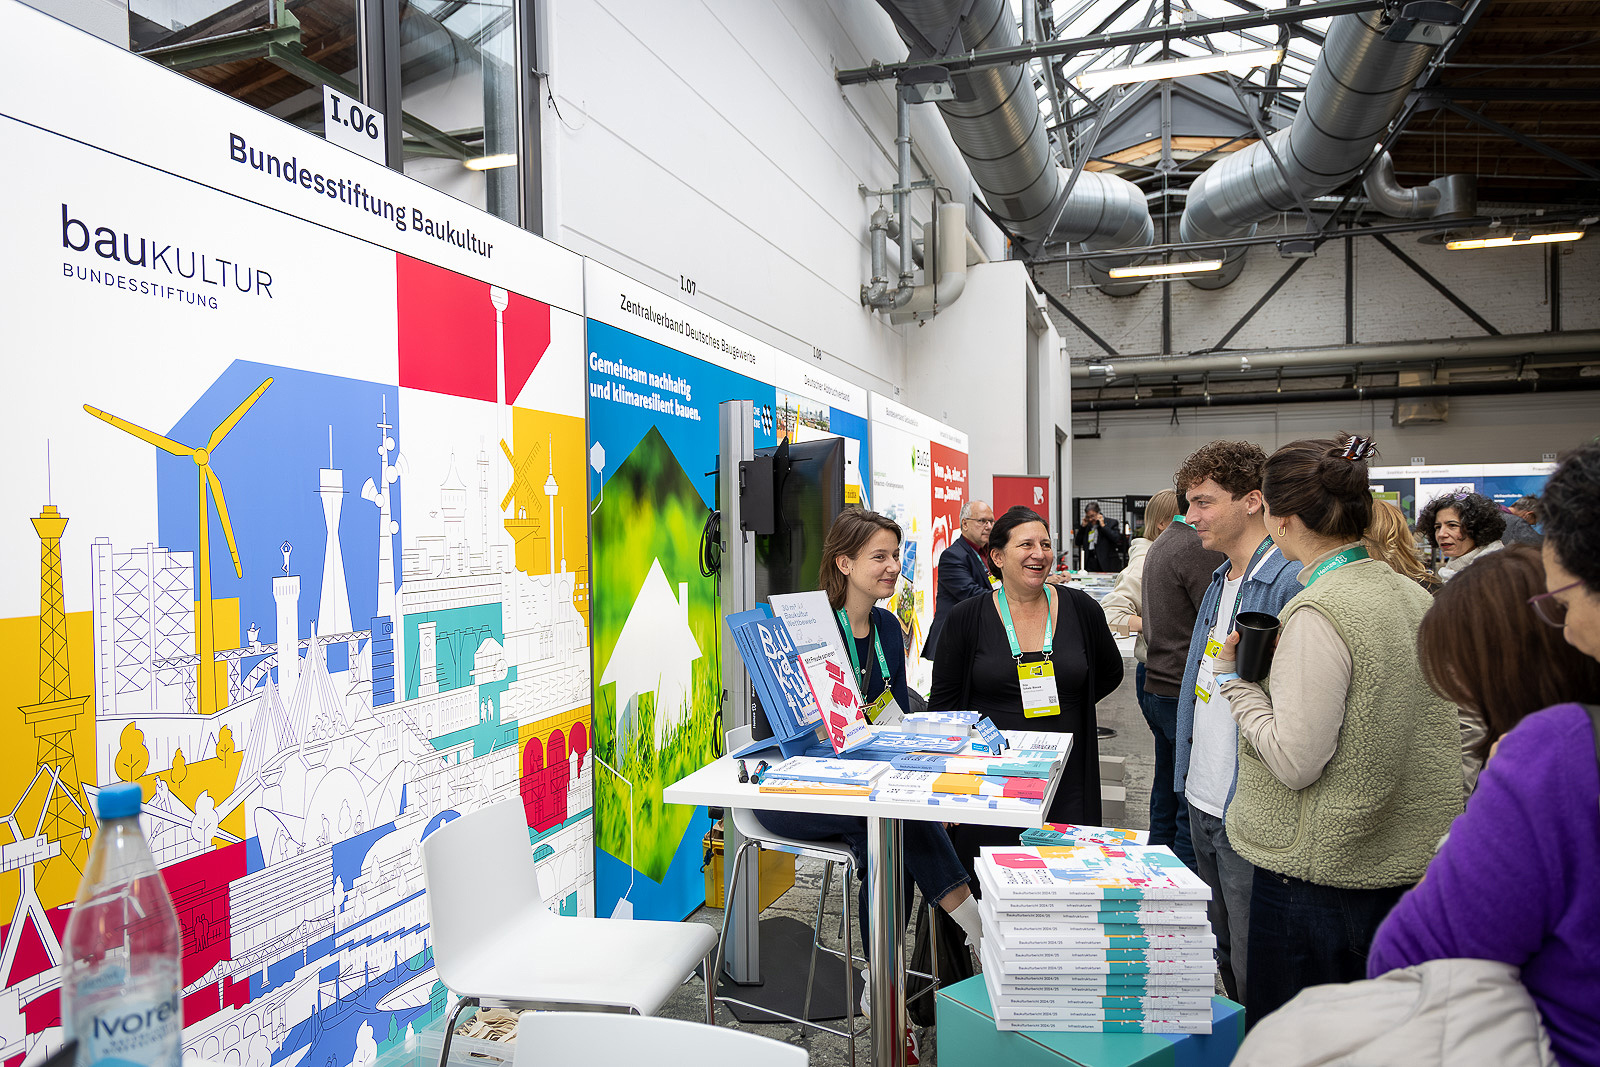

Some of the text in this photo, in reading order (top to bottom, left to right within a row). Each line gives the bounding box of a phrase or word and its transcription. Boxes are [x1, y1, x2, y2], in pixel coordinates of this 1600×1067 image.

[330, 95, 380, 140] I.06
[228, 133, 494, 260] Bundesstiftung Baukultur
[62, 203, 274, 299] bauKULTUR
[63, 263, 218, 310] BUNDESSTIFTUNG
[680, 274, 696, 296] I.07
[620, 293, 756, 365] Zentralverband Deutsches Baugewerbe
[589, 352, 692, 402] Gemeinsam nachhaltig
[590, 380, 701, 422] und klimaresilient bauen.
[1317, 561, 1336, 576] Heinze
[784, 610, 808, 620] Baukultur
[786, 618, 817, 627] Wettbewerb
